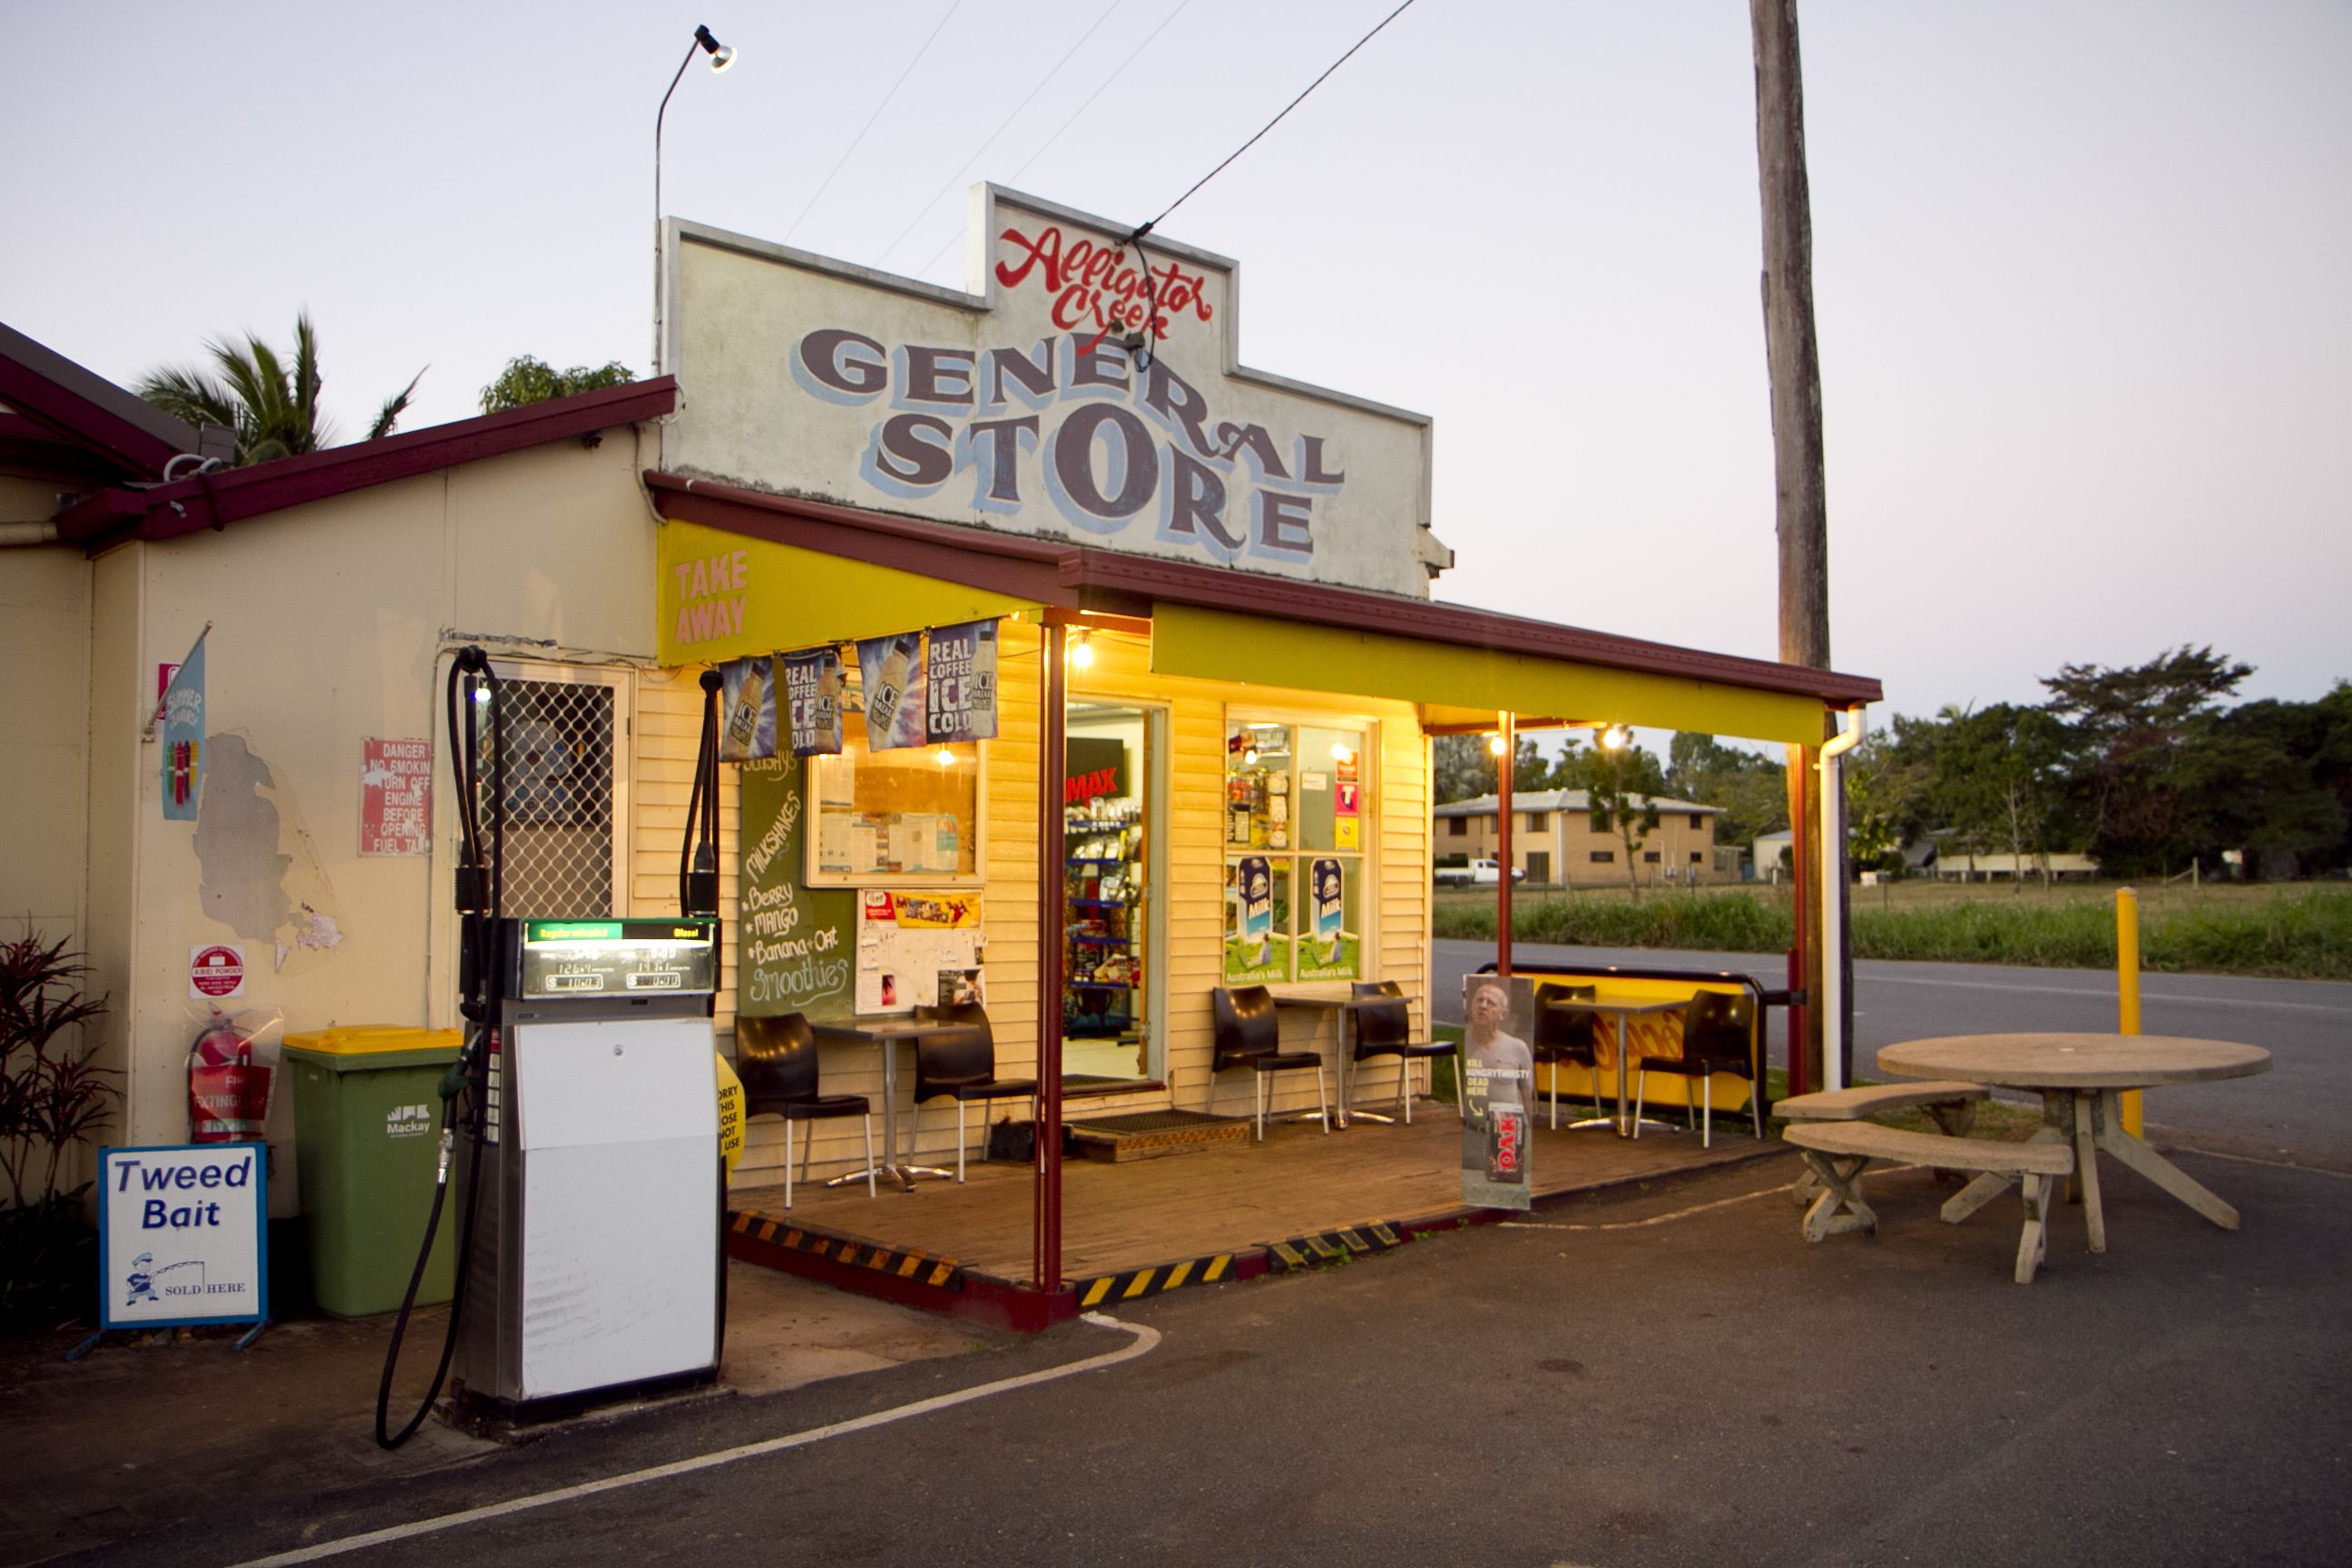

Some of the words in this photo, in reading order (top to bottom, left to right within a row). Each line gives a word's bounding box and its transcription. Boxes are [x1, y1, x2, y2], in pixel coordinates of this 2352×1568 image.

[995, 227, 1212, 322] Alligator
[1051, 284, 1169, 358] Creek
[793, 328, 1345, 493] GENERAL
[864, 403, 1314, 561] STORE
[675, 550, 747, 600] TAKE
[675, 595, 747, 645] AWAY
[930, 638, 971, 663] REAL
[930, 660, 971, 680] COFFEE
[975, 671, 993, 690] ICE
[789, 684, 816, 700] OFFEE
[877, 683, 899, 709] ICE
[929, 676, 972, 713] ICE
[818, 695, 834, 711] ICE
[736, 701, 757, 726] ICE
[791, 698, 816, 730] CE
[929, 710, 973, 734] COLD
[792, 729, 816, 750] OLD
[383, 743, 426, 759] DANGER
[370, 760, 385, 771] NO
[390, 760, 431, 774] SMOKIN
[382, 776, 407, 789] URN
[410, 776, 431, 790] OFF
[385, 791, 423, 806] ENGINE
[383, 808, 424, 822] BEFORE
[381, 822, 426, 837] OPENING
[374, 838, 399, 852] FUEL
[1248, 897, 1270, 919] Milk
[1320, 897, 1341, 919] Milk
[673, 927, 699, 937] Diesel
[1338, 965, 1354, 975] Milk
[1466, 1058, 1483, 1068] KILL
[1467, 1077, 1488, 1087] DEAD
[719, 1084, 739, 1100] ORRY
[1466, 1086, 1488, 1096] HERE
[720, 1100, 735, 1112] HIS
[387, 1120, 430, 1134] Mackay
[721, 1112, 738, 1126] OSE
[724, 1137, 740, 1151] USE
[1497, 1117, 1517, 1170] OAK
[114, 1156, 251, 1192] Tweed
[142, 1199, 220, 1230] Bait
[165, 1285, 201, 1296] SOLD
[207, 1282, 246, 1294] HERE
